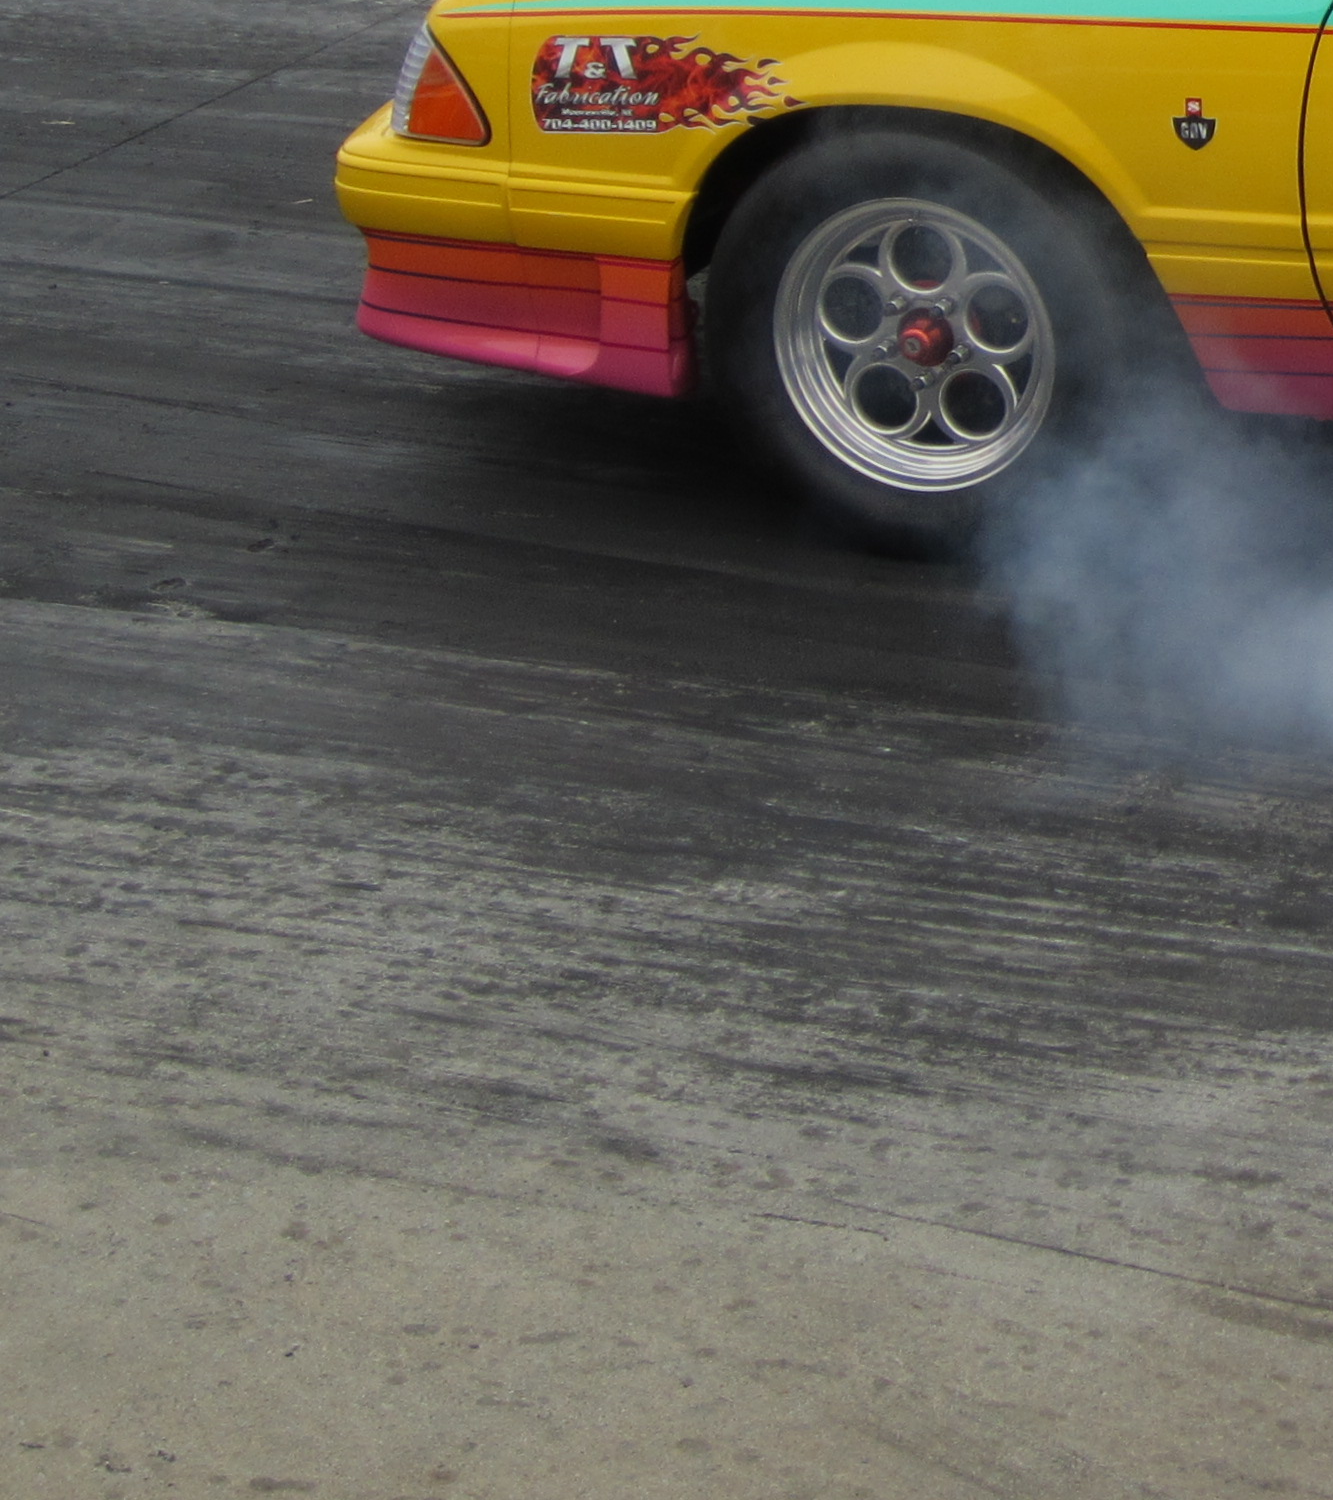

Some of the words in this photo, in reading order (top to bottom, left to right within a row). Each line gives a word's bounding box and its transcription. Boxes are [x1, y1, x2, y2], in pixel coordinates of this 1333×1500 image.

[554, 37, 590, 79] T
[584, 62, 607, 79] &
[600, 37, 637, 80] T
[535, 82, 659, 106] Fabrication
[542, 118, 657, 131] 704-400-1409
